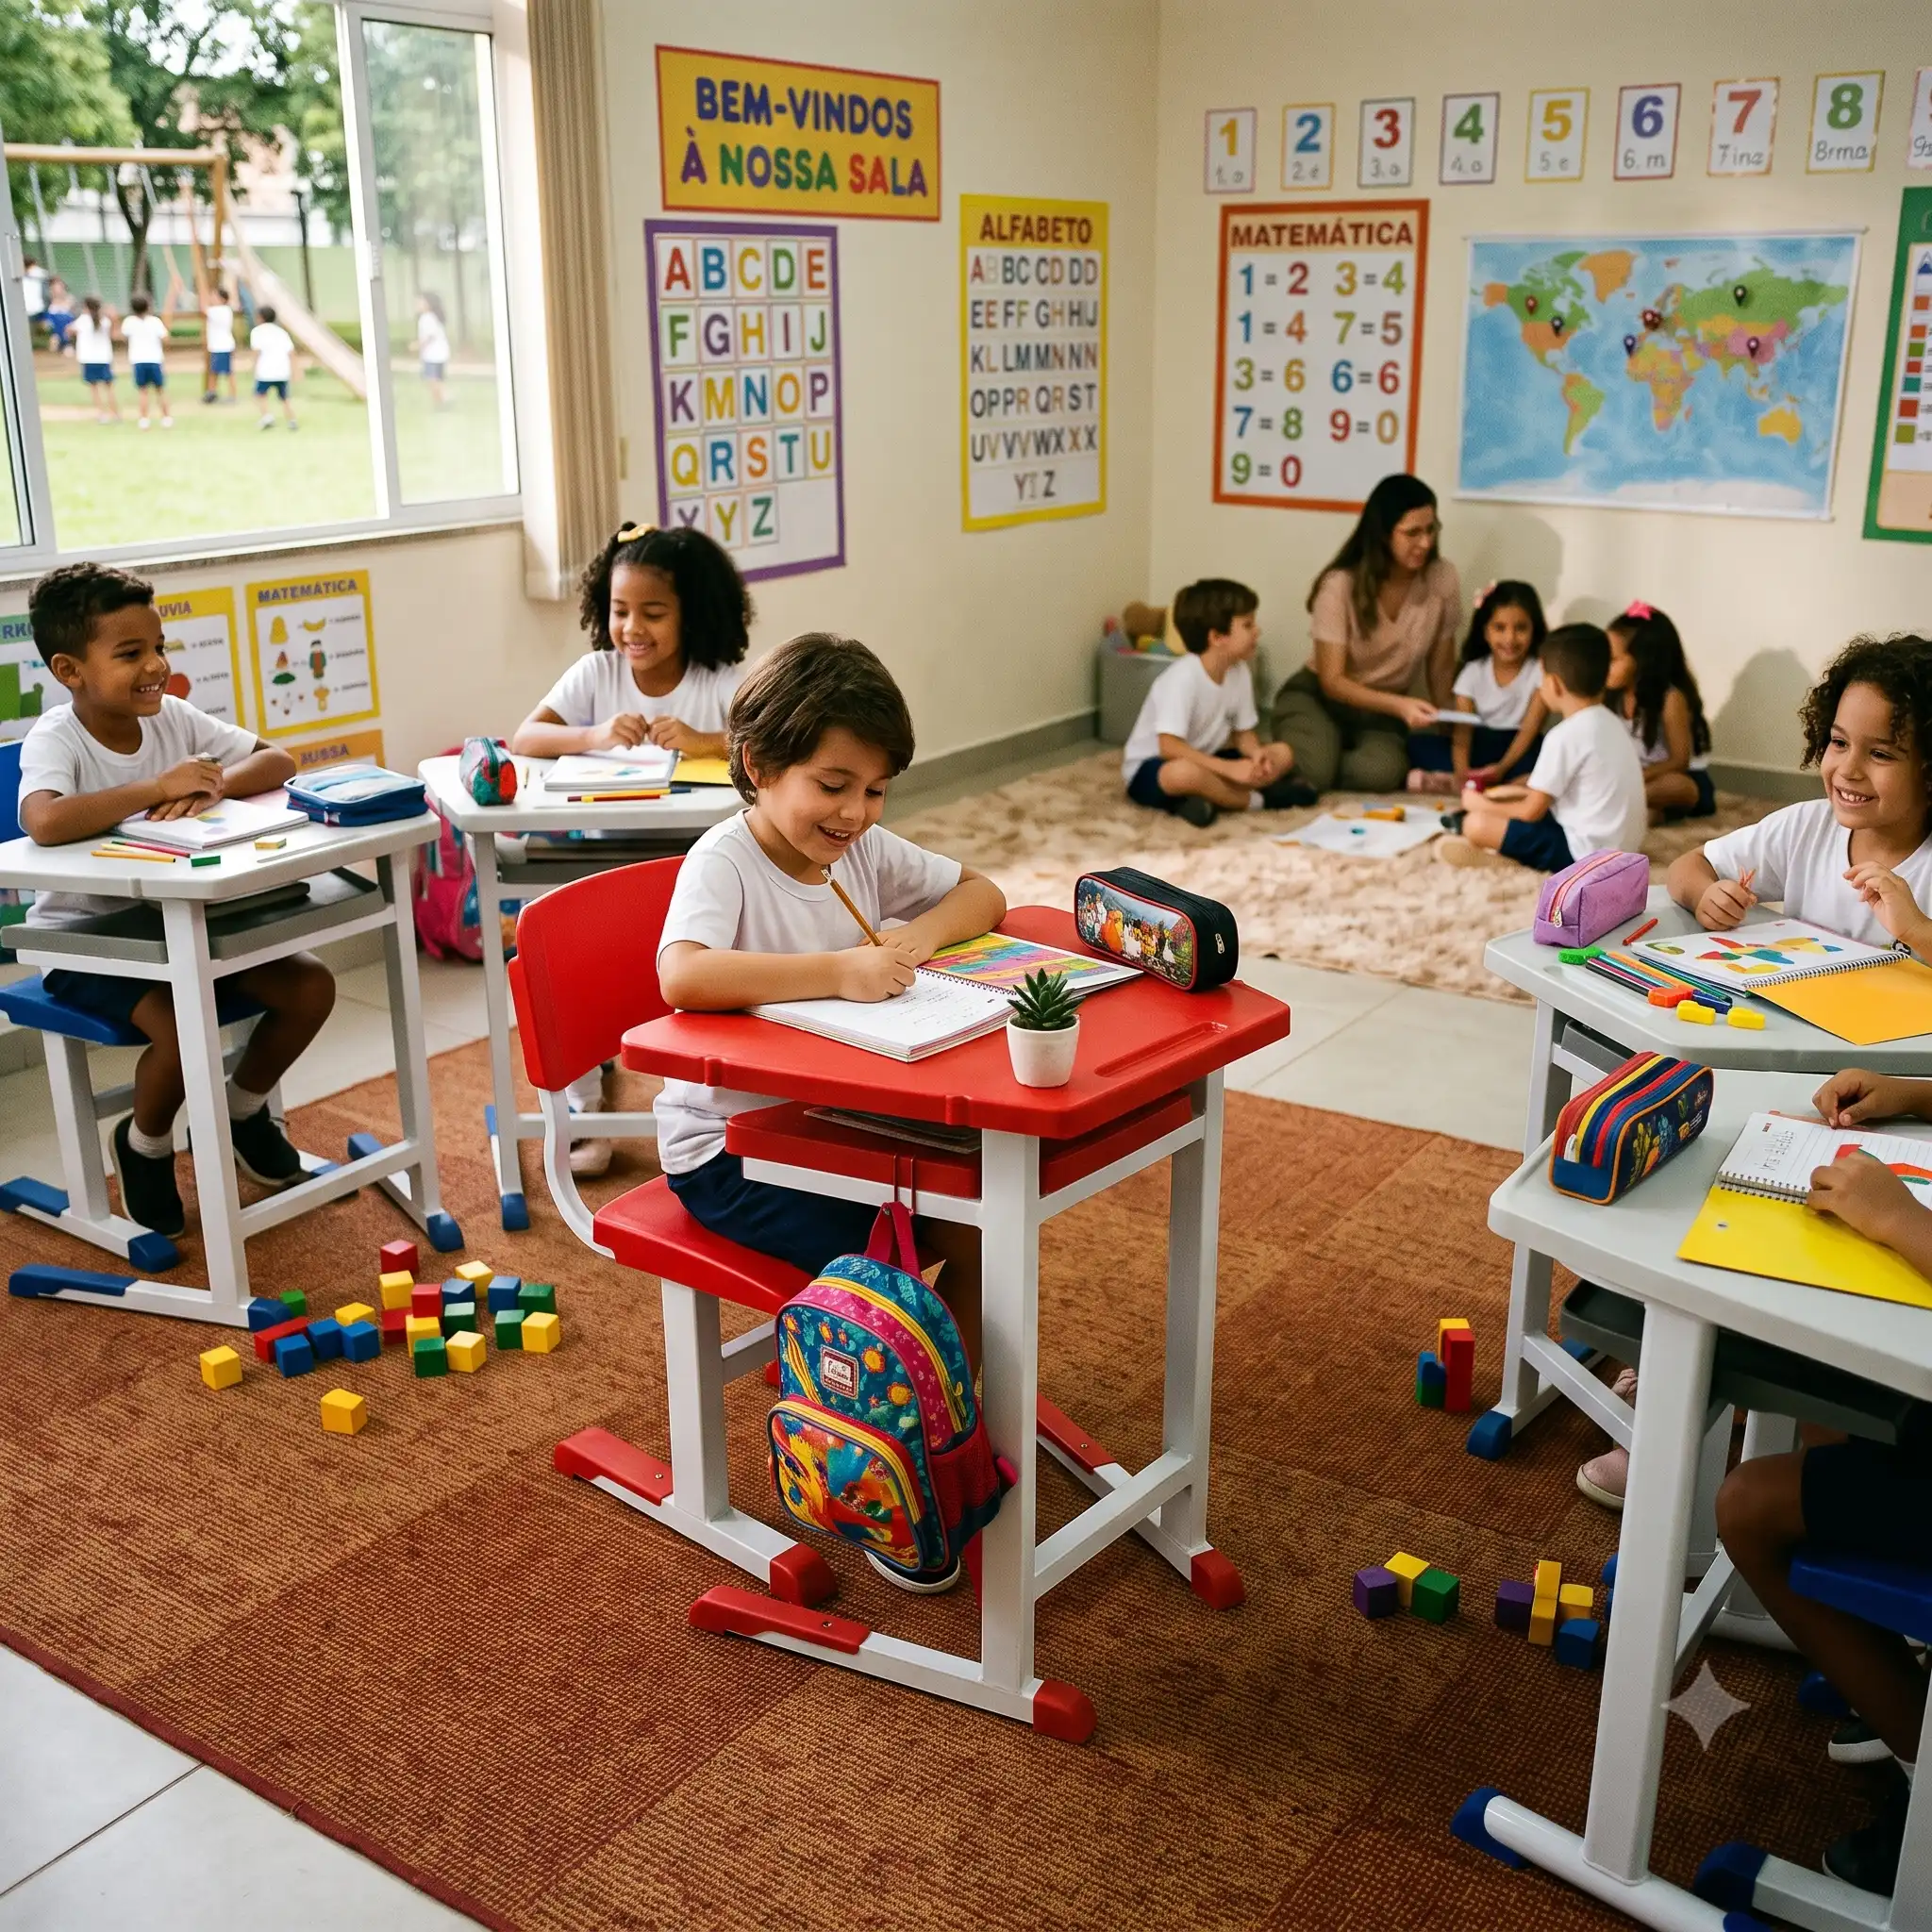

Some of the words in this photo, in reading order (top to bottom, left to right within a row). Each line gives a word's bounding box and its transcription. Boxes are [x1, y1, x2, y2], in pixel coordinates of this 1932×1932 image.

[695, 75, 913, 140] BEM-VINDOS
[1452, 103, 1484, 144] 4
[1541, 98, 1572, 142] 5
[1632, 94, 1664, 139] 6
[1727, 89, 1762, 134] 7
[1826, 82, 1863, 130] 8
[1219, 118, 1239, 157] 1
[1294, 112, 1322, 154] 2
[1373, 108, 1401, 150] 3
[680, 125, 707, 185] À
[719, 143, 839, 192] NOSSA
[848, 152, 928, 198] SALA
[979, 211, 1093, 244] ALFABETO
[1230, 217, 1413, 247] MATEMÁTICA
[664, 246, 691, 291] A
[702, 246, 727, 291] B
[738, 246, 762, 291] C
[773, 248, 795, 290] D
[807, 249, 826, 290] E
[1238, 261, 1254, 297] 1
[1288, 261, 1309, 295] 2
[1335, 260, 1357, 296] 3
[1382, 259, 1406, 296] 4
[669, 314, 689, 358] F
[704, 313, 730, 357] G
[741, 312, 765, 355] H
[783, 311, 790, 353] I
[810, 310, 826, 352] J
[1237, 309, 1252, 343] 1
[1285, 309, 1307, 344] 4
[1333, 310, 1357, 345] 7
[1380, 311, 1403, 346] 5
[1233, 358, 1255, 391] 3
[1284, 358, 1306, 393] 6
[1331, 359, 1354, 393] 6
[1377, 359, 1400, 395] 6
[670, 379, 695, 423] K
[704, 376, 735, 421] M
[744, 374, 768, 417] N
[776, 373, 801, 414] O
[810, 372, 828, 412] P
[1233, 406, 1254, 439] 7
[1281, 407, 1303, 441] 8
[1329, 408, 1351, 442] 9
[1375, 409, 1399, 445] 0
[672, 443, 699, 487] Q
[710, 441, 734, 482] R
[747, 437, 768, 478] S
[779, 433, 799, 475] T
[810, 430, 830, 471] U
[1231, 452, 1252, 485] 9
[1280, 454, 1302, 489] 0
[715, 501, 738, 541] Y
[752, 497, 773, 537] Z
